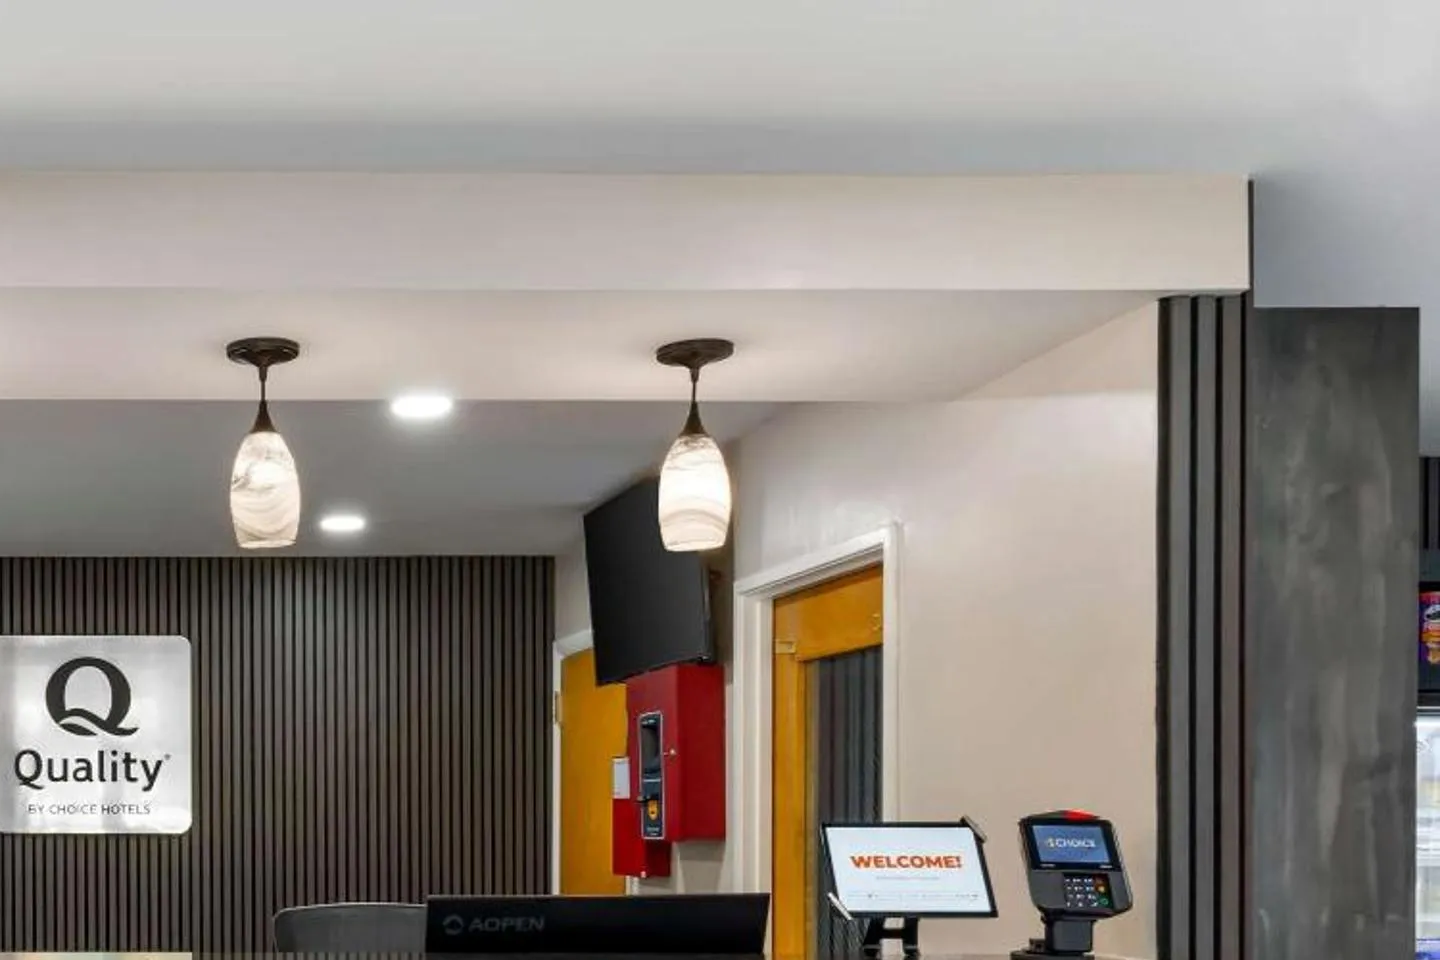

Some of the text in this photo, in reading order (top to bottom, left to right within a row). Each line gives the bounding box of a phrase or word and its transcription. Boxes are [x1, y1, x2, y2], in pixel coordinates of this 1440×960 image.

[45, 656, 139, 736] Q
[13, 749, 163, 792] Quality
[27, 803, 151, 816] BY CHOICE HOTELS
[849, 855, 962, 869] WELCOME!
[468, 916, 545, 933] AOPEN
